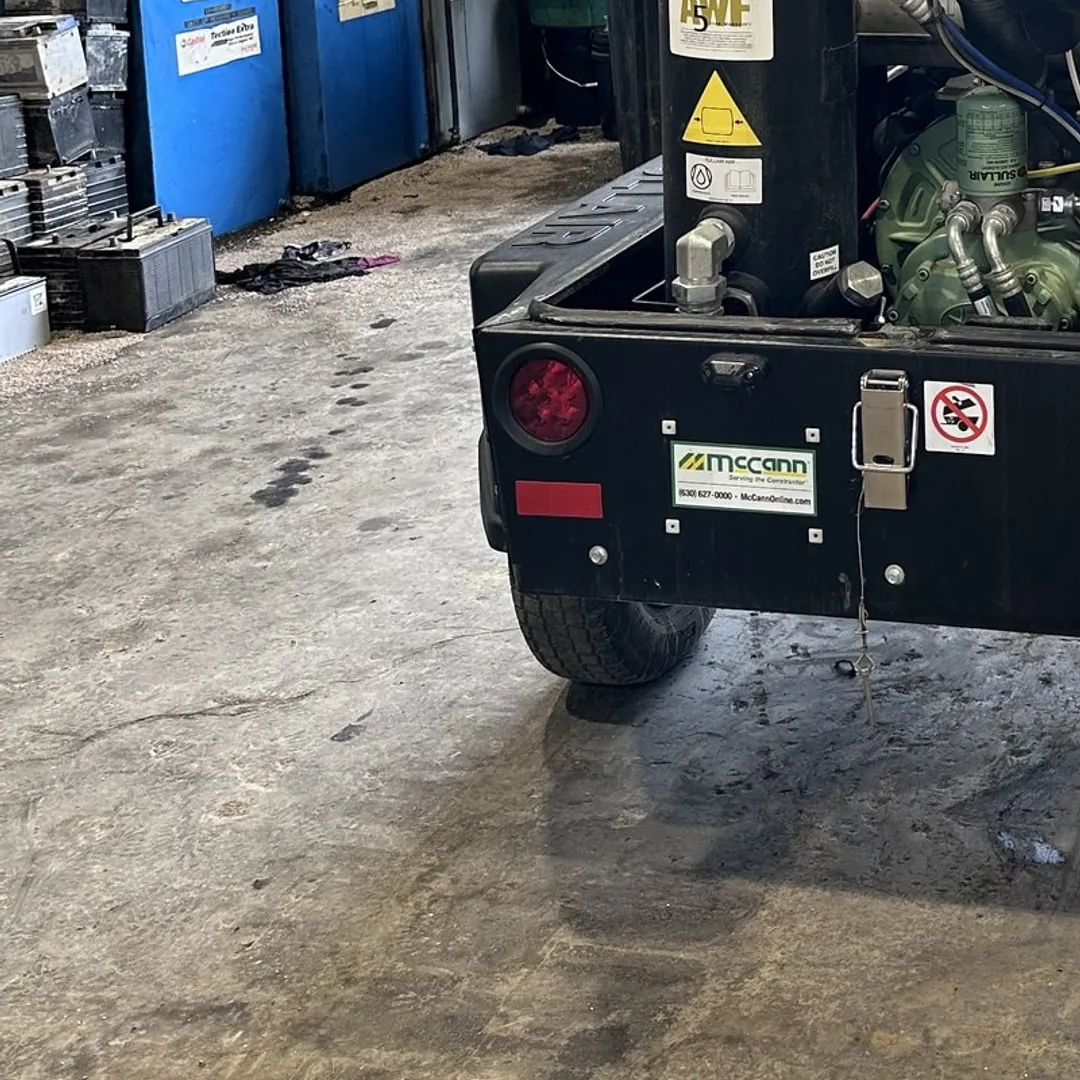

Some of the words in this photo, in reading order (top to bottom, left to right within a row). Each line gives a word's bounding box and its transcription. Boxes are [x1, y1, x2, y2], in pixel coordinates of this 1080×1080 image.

[693, 5, 708, 32] 5
[969, 169, 1018, 180] SULLAIR
[679, 489, 697, 499] (630)
[698, 490, 733, 500] 627-0000
[740, 492, 812, 506] McCannOnline.com
